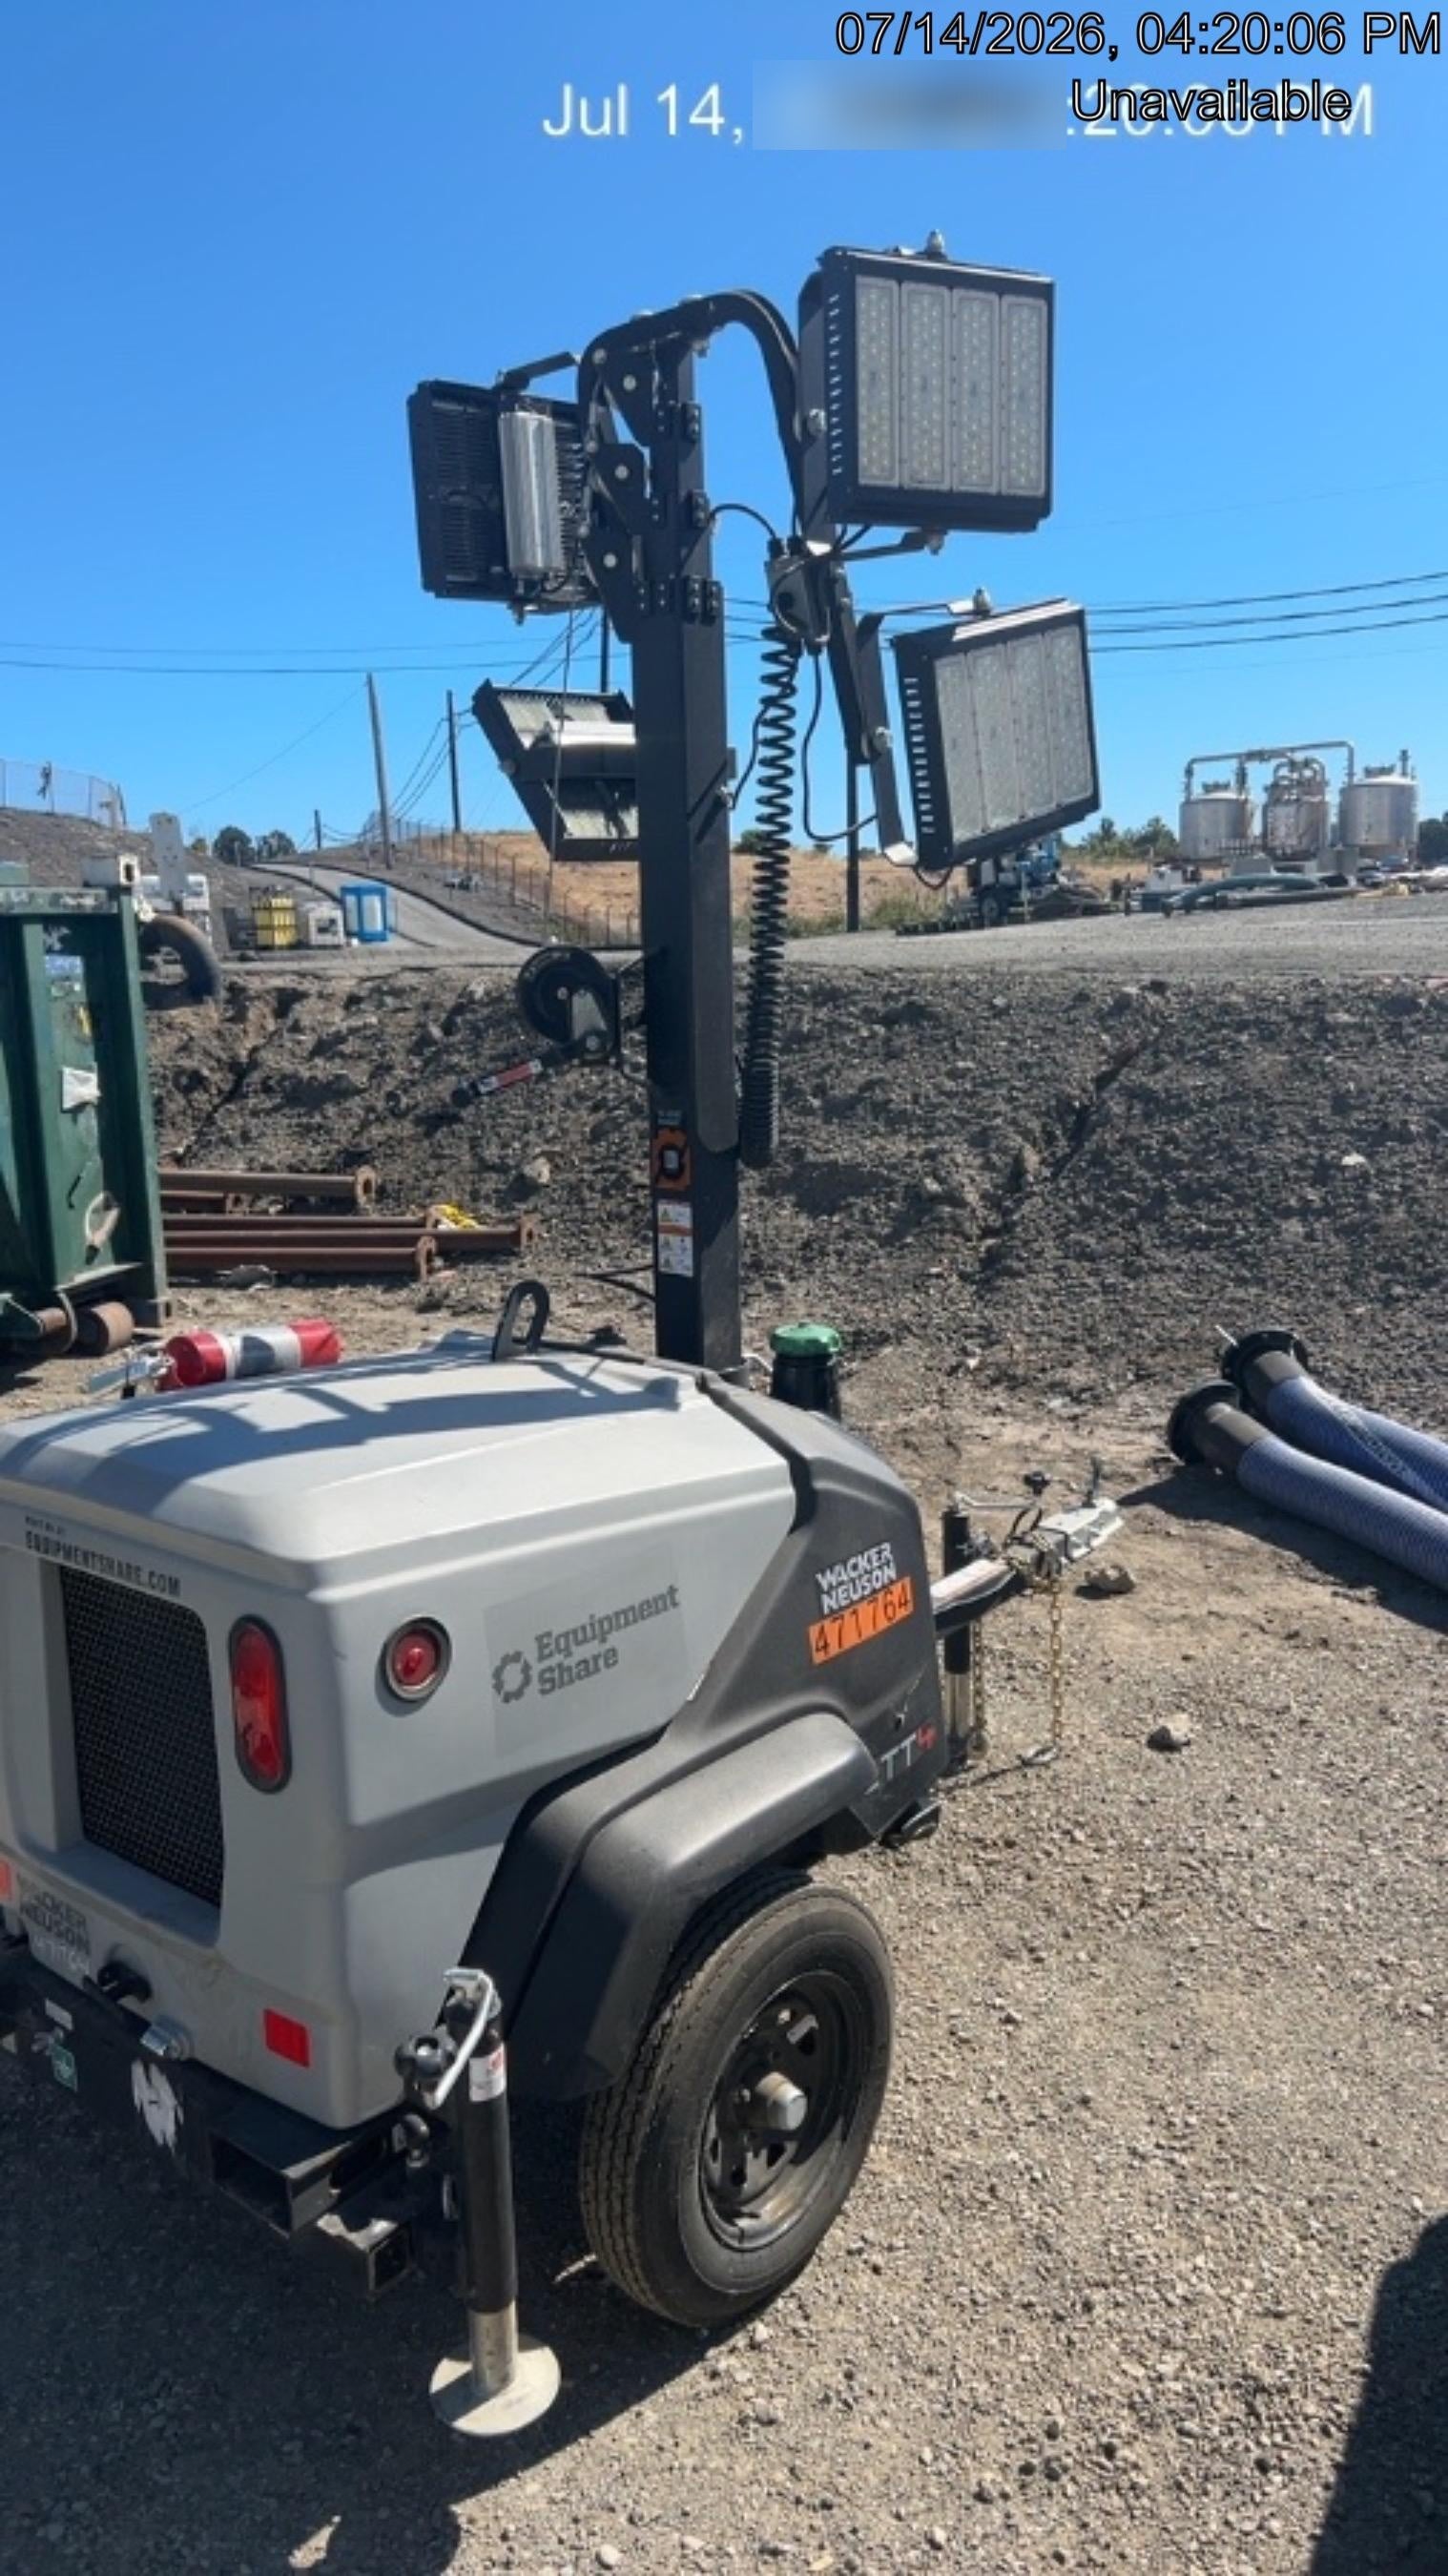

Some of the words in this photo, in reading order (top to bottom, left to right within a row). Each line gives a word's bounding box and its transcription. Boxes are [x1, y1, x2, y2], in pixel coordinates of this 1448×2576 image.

[815, 1542, 893, 1591] WACKER
[820, 1565, 897, 1615] NEUSON
[534, 1585, 679, 1664] Equipment
[816, 1582, 909, 1655] 471764
[537, 1647, 619, 1696] Share
